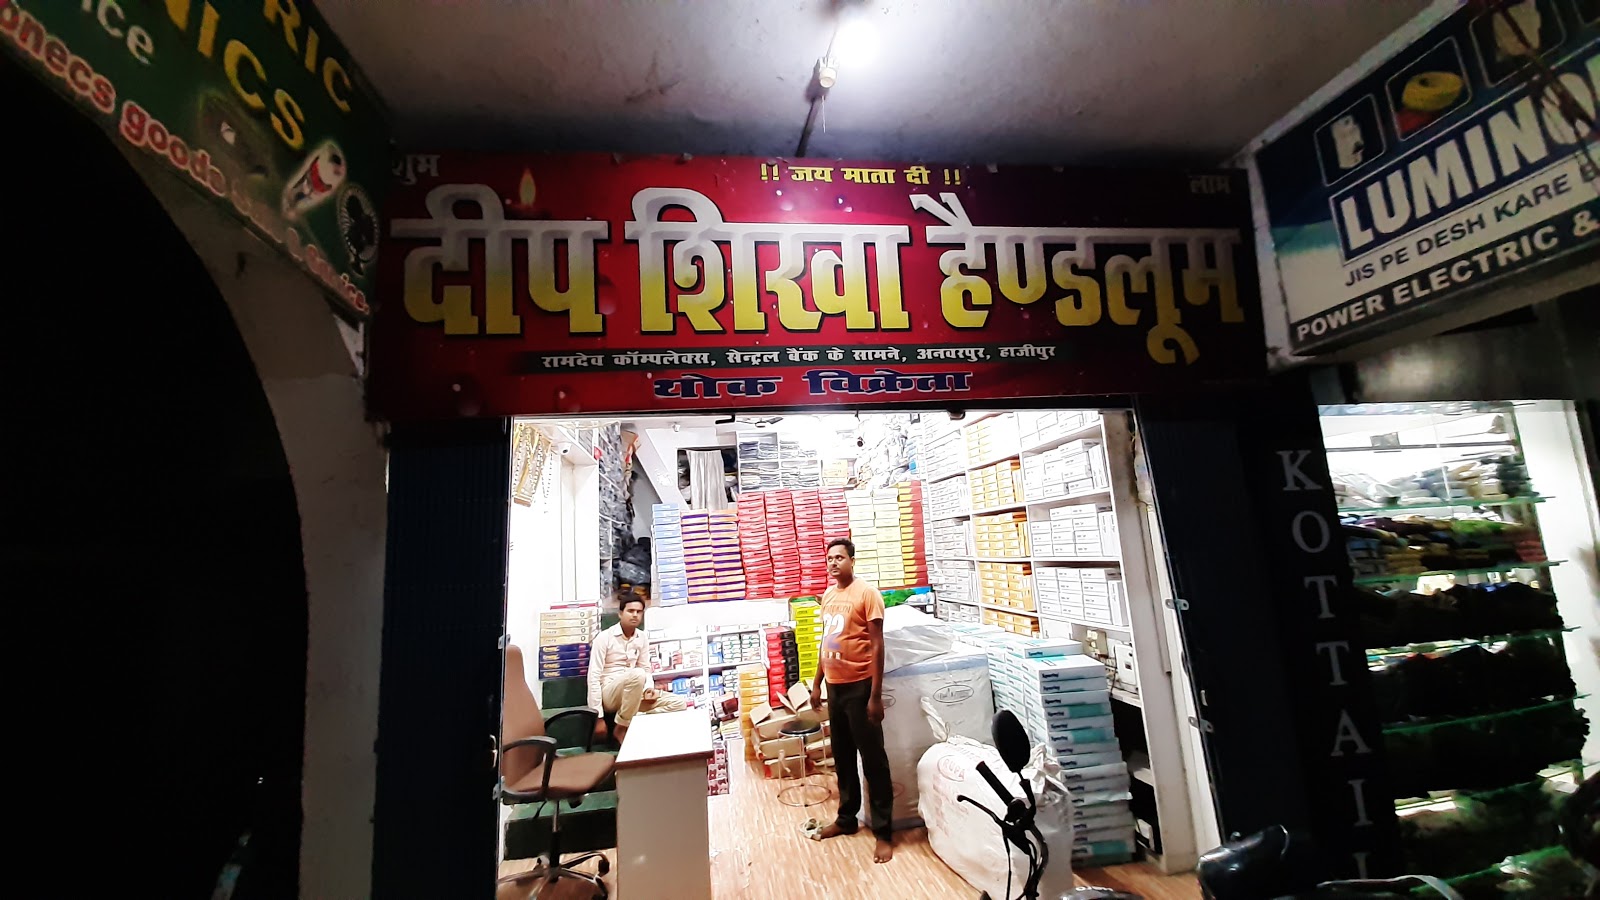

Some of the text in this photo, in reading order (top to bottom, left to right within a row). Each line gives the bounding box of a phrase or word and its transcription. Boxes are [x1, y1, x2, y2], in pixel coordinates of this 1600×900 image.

[788, 166, 834, 183] जय
[840, 167, 896, 184] माता
[903, 164, 931, 185] दी
[1345, 263, 1374, 287] JIS
[1381, 244, 1410, 272] PE
[1417, 210, 1486, 256] DESH
[1493, 173, 1572, 223] KARE
[391, 183, 609, 336] दीप
[623, 187, 910, 333] शिखा
[909, 192, 1246, 366] हैण्डलूम
[1297, 209, 1600, 342] POWER ELECTRIC &
[541, 343, 1056, 368] रामदेव कॉम्पलेक्स, सेन्ट्रल बैंक के सामने, अनवरपुर, हाजीपुर
[653, 368, 973, 399] थोक विक्रेता
